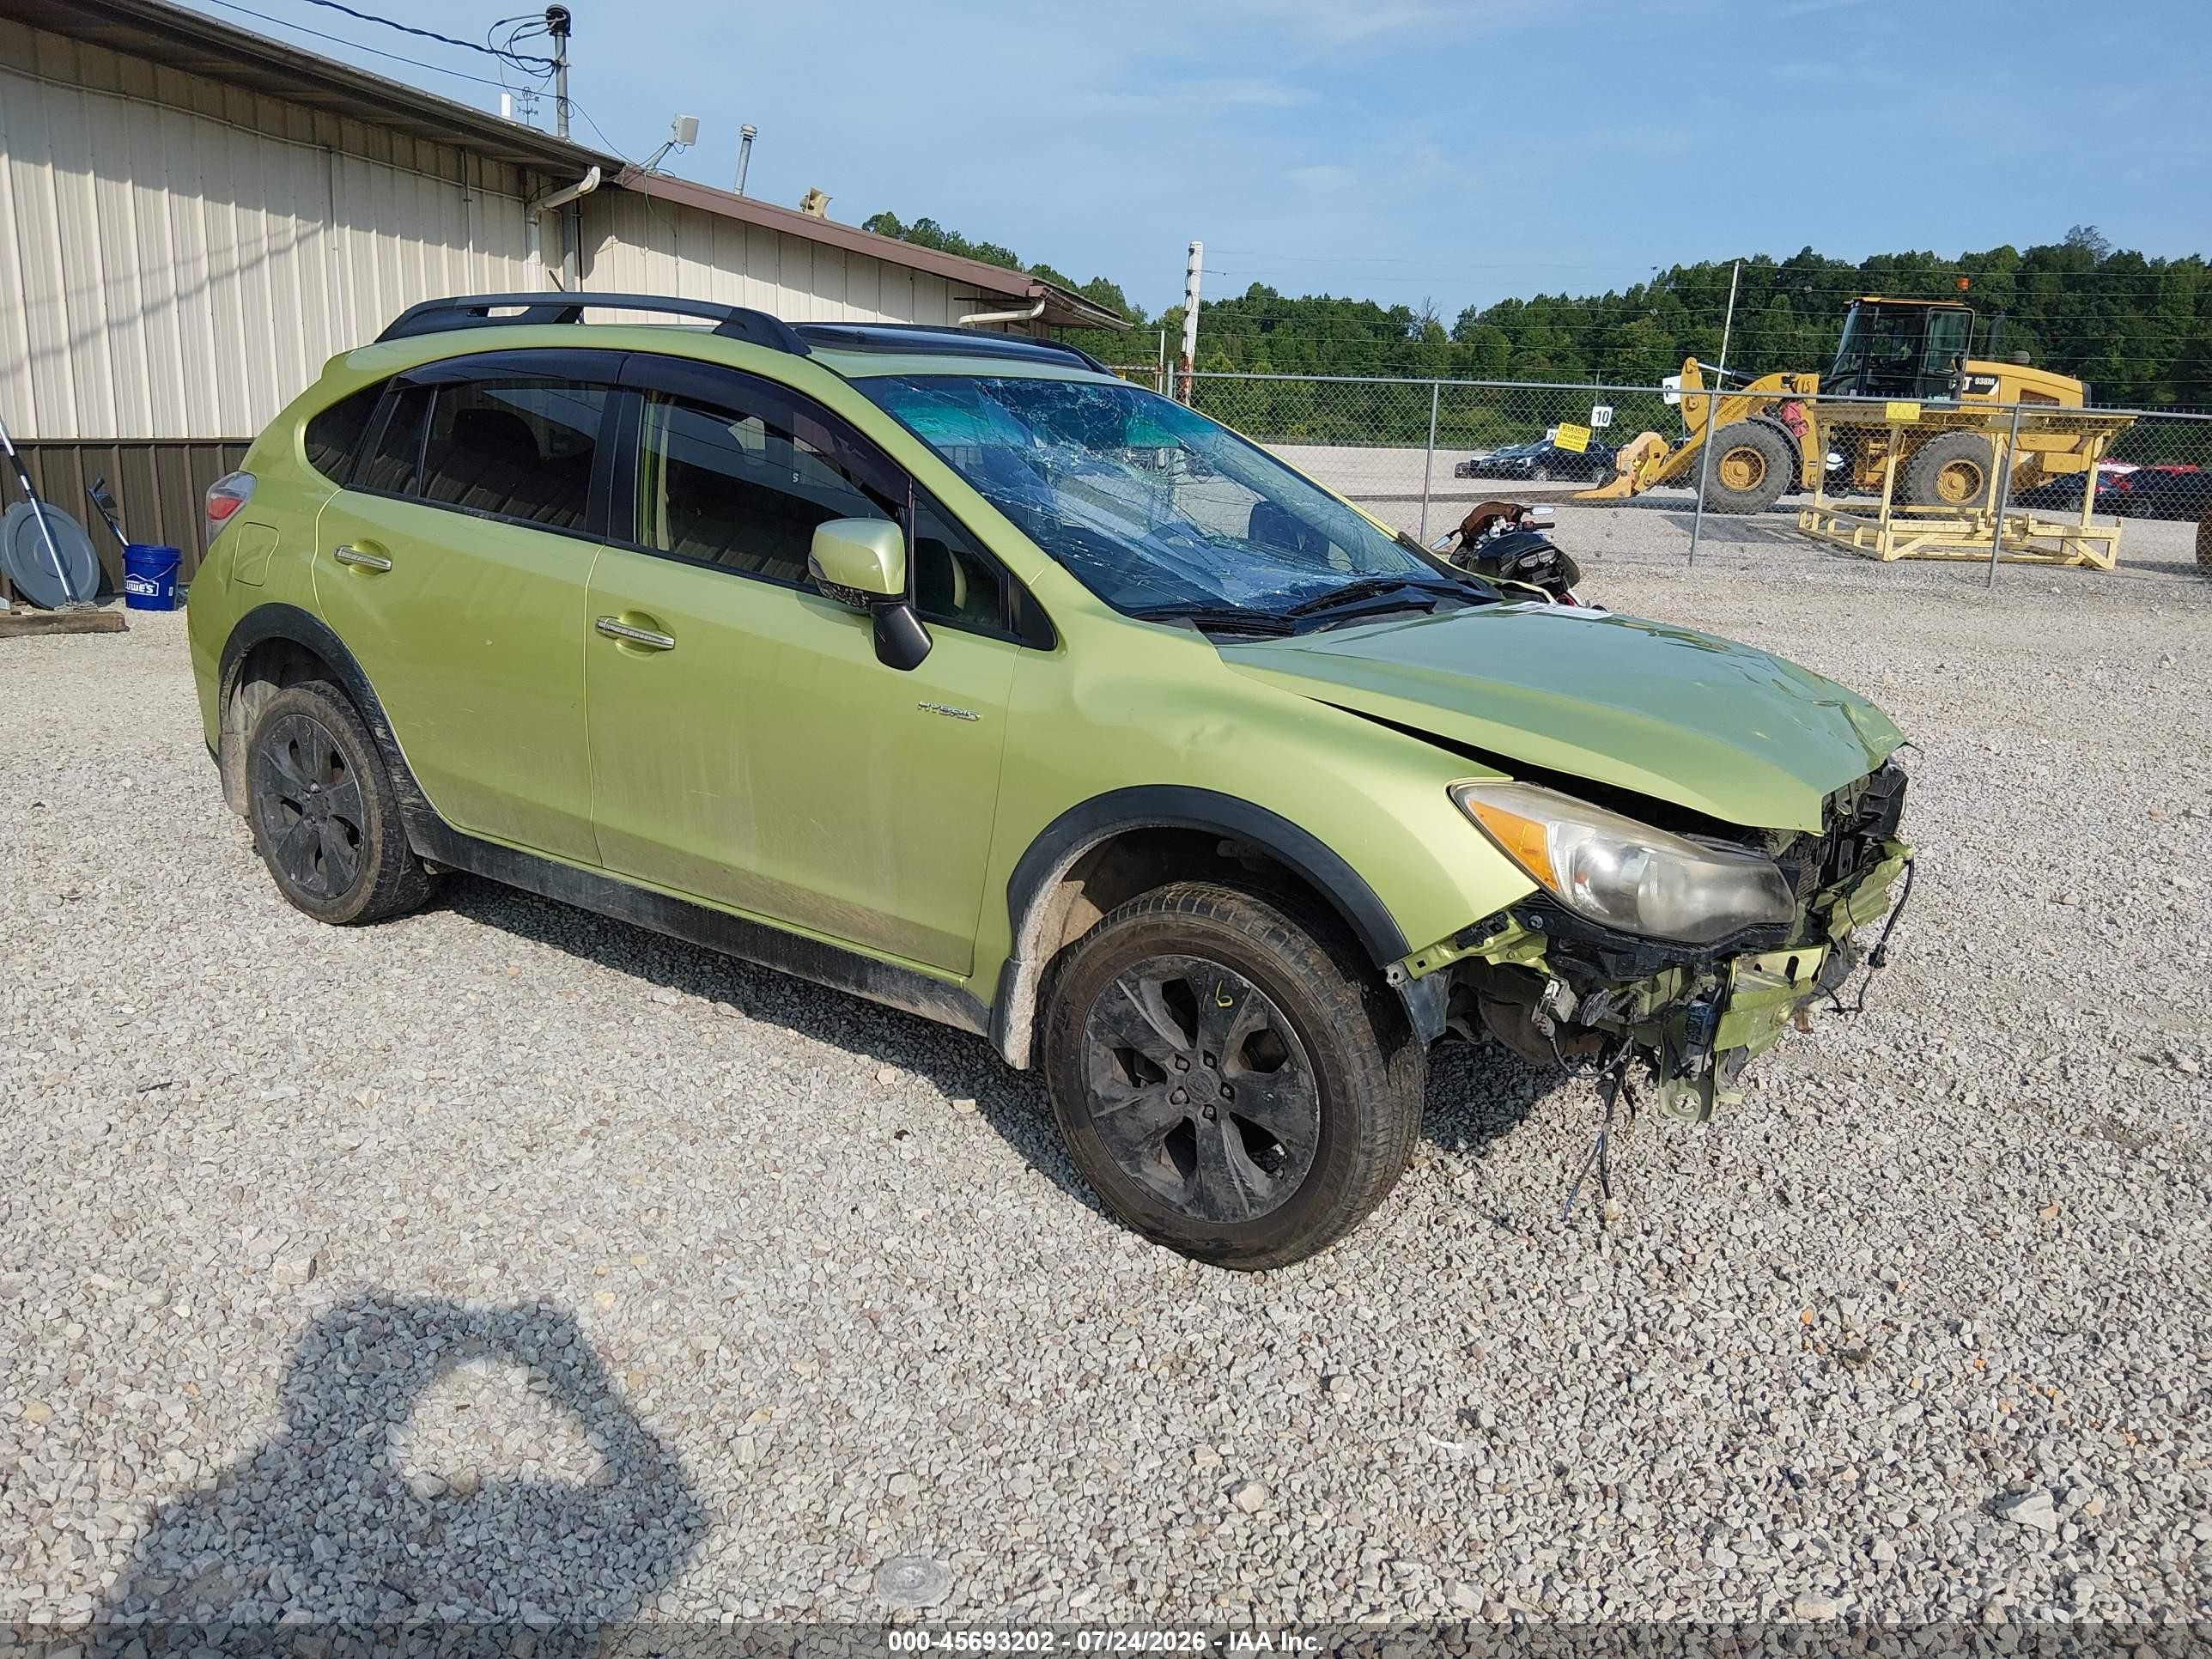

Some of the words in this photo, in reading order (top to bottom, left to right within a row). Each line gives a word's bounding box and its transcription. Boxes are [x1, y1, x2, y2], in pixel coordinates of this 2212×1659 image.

[1948, 377, 1972, 391] CT
[1595, 410, 1610, 423] 10
[1215, 979, 1234, 1008] 6
